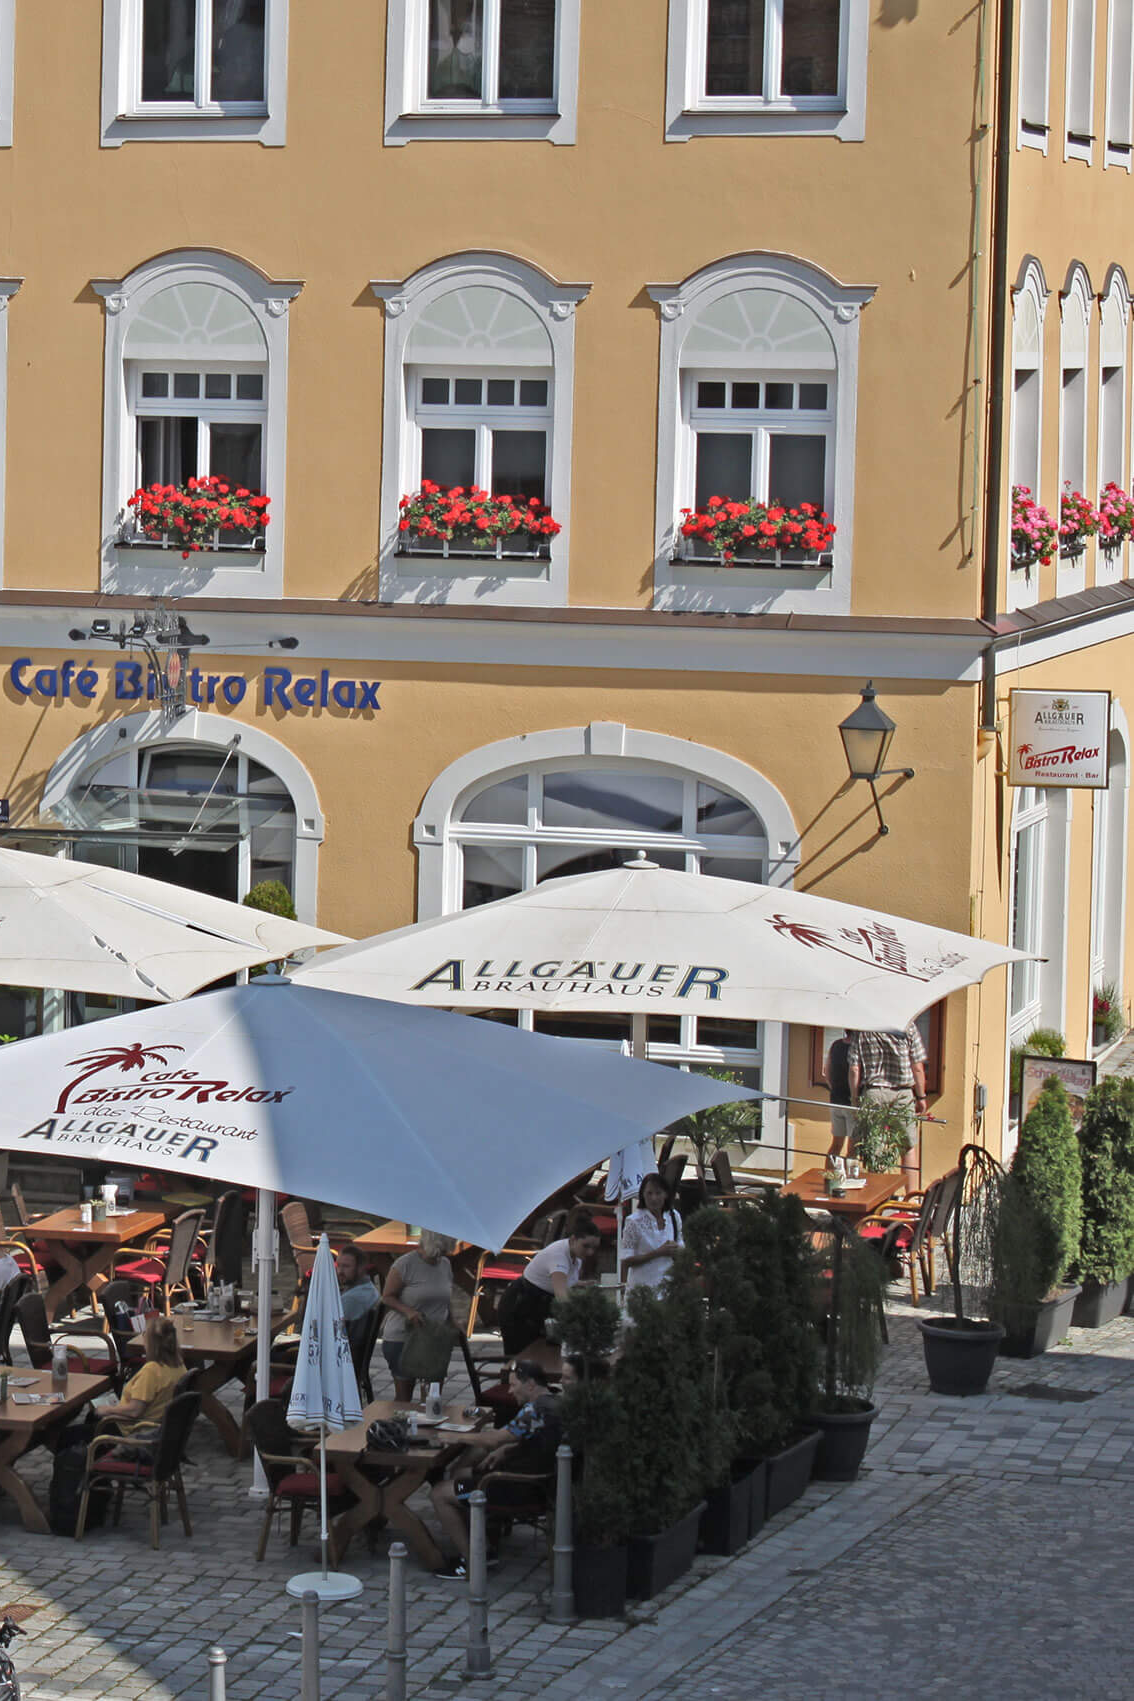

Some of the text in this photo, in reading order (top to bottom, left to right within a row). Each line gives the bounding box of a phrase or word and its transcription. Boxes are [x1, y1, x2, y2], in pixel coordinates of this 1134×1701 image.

[10, 657, 383, 711] Café Bitro Relax
[1024, 745, 1100, 770] Bistro Relax
[1035, 771, 1079, 779] Restaurant
[407, 958, 730, 1001] ALLGÄUER
[471, 980, 665, 998] BRAUHAUS
[71, 1080, 292, 1105] Bistro Relax
[130, 1105, 259, 1142] Restaurant
[57, 1133, 175, 1157] BRAUHAUS
